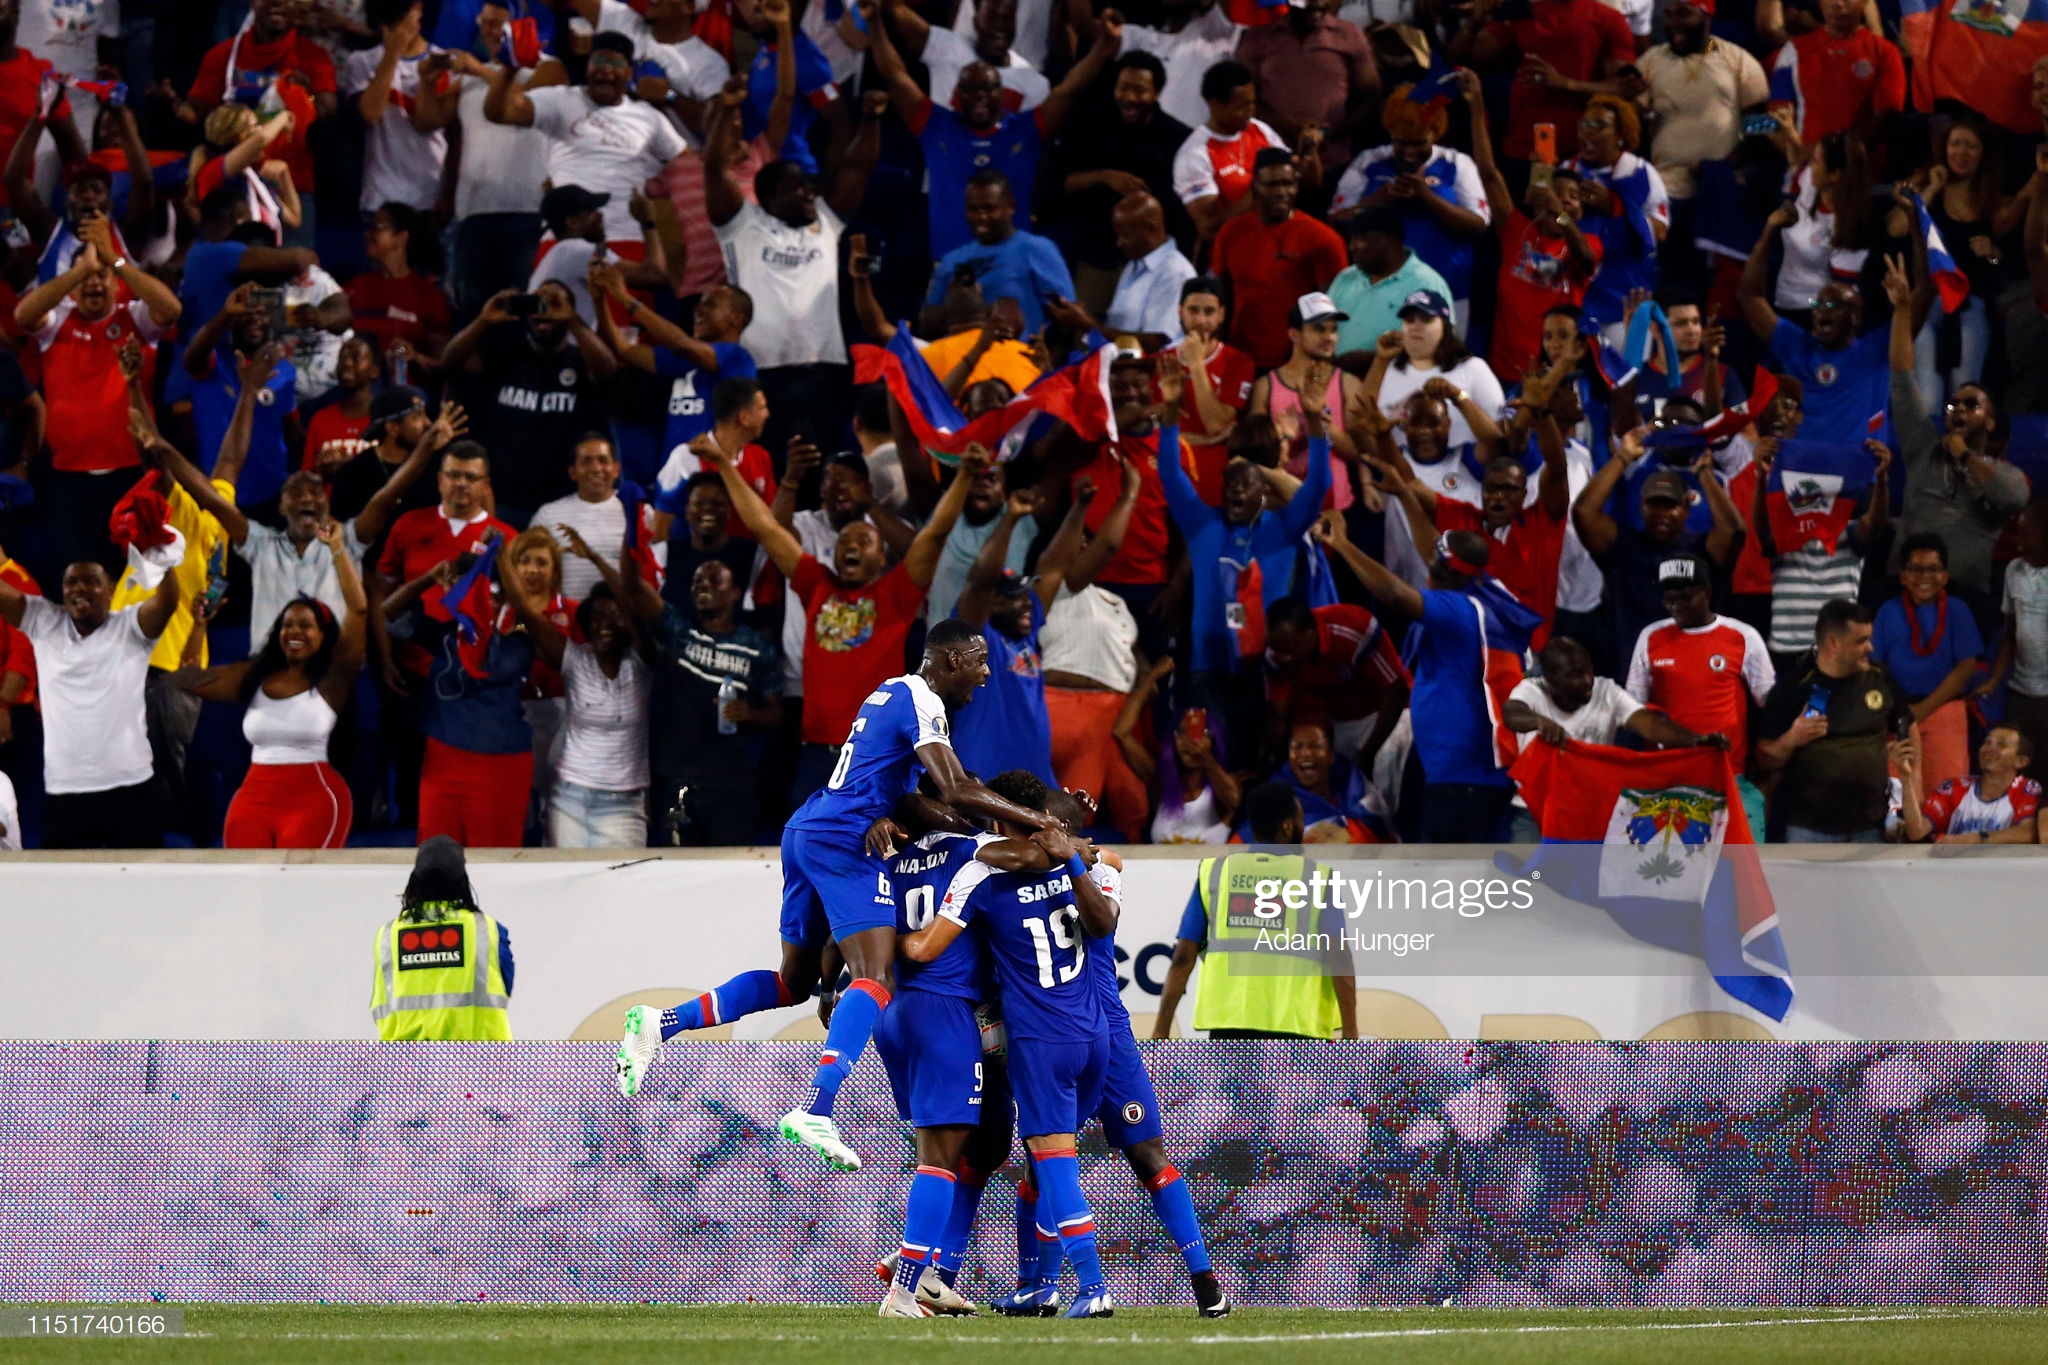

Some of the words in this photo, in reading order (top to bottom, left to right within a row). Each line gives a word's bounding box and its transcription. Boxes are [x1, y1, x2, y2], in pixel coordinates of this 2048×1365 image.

[498, 386, 539, 412] MAN
[541, 392, 577, 413] CITY
[828, 717, 867, 790] 6
[878, 872, 891, 896] 6
[1017, 874, 1073, 904] SABA
[1229, 916, 1283, 929] SECURITAS
[401, 951, 460, 964] SECURITAS
[1023, 904, 1085, 989] 19
[974, 1062, 983, 1092] 9
